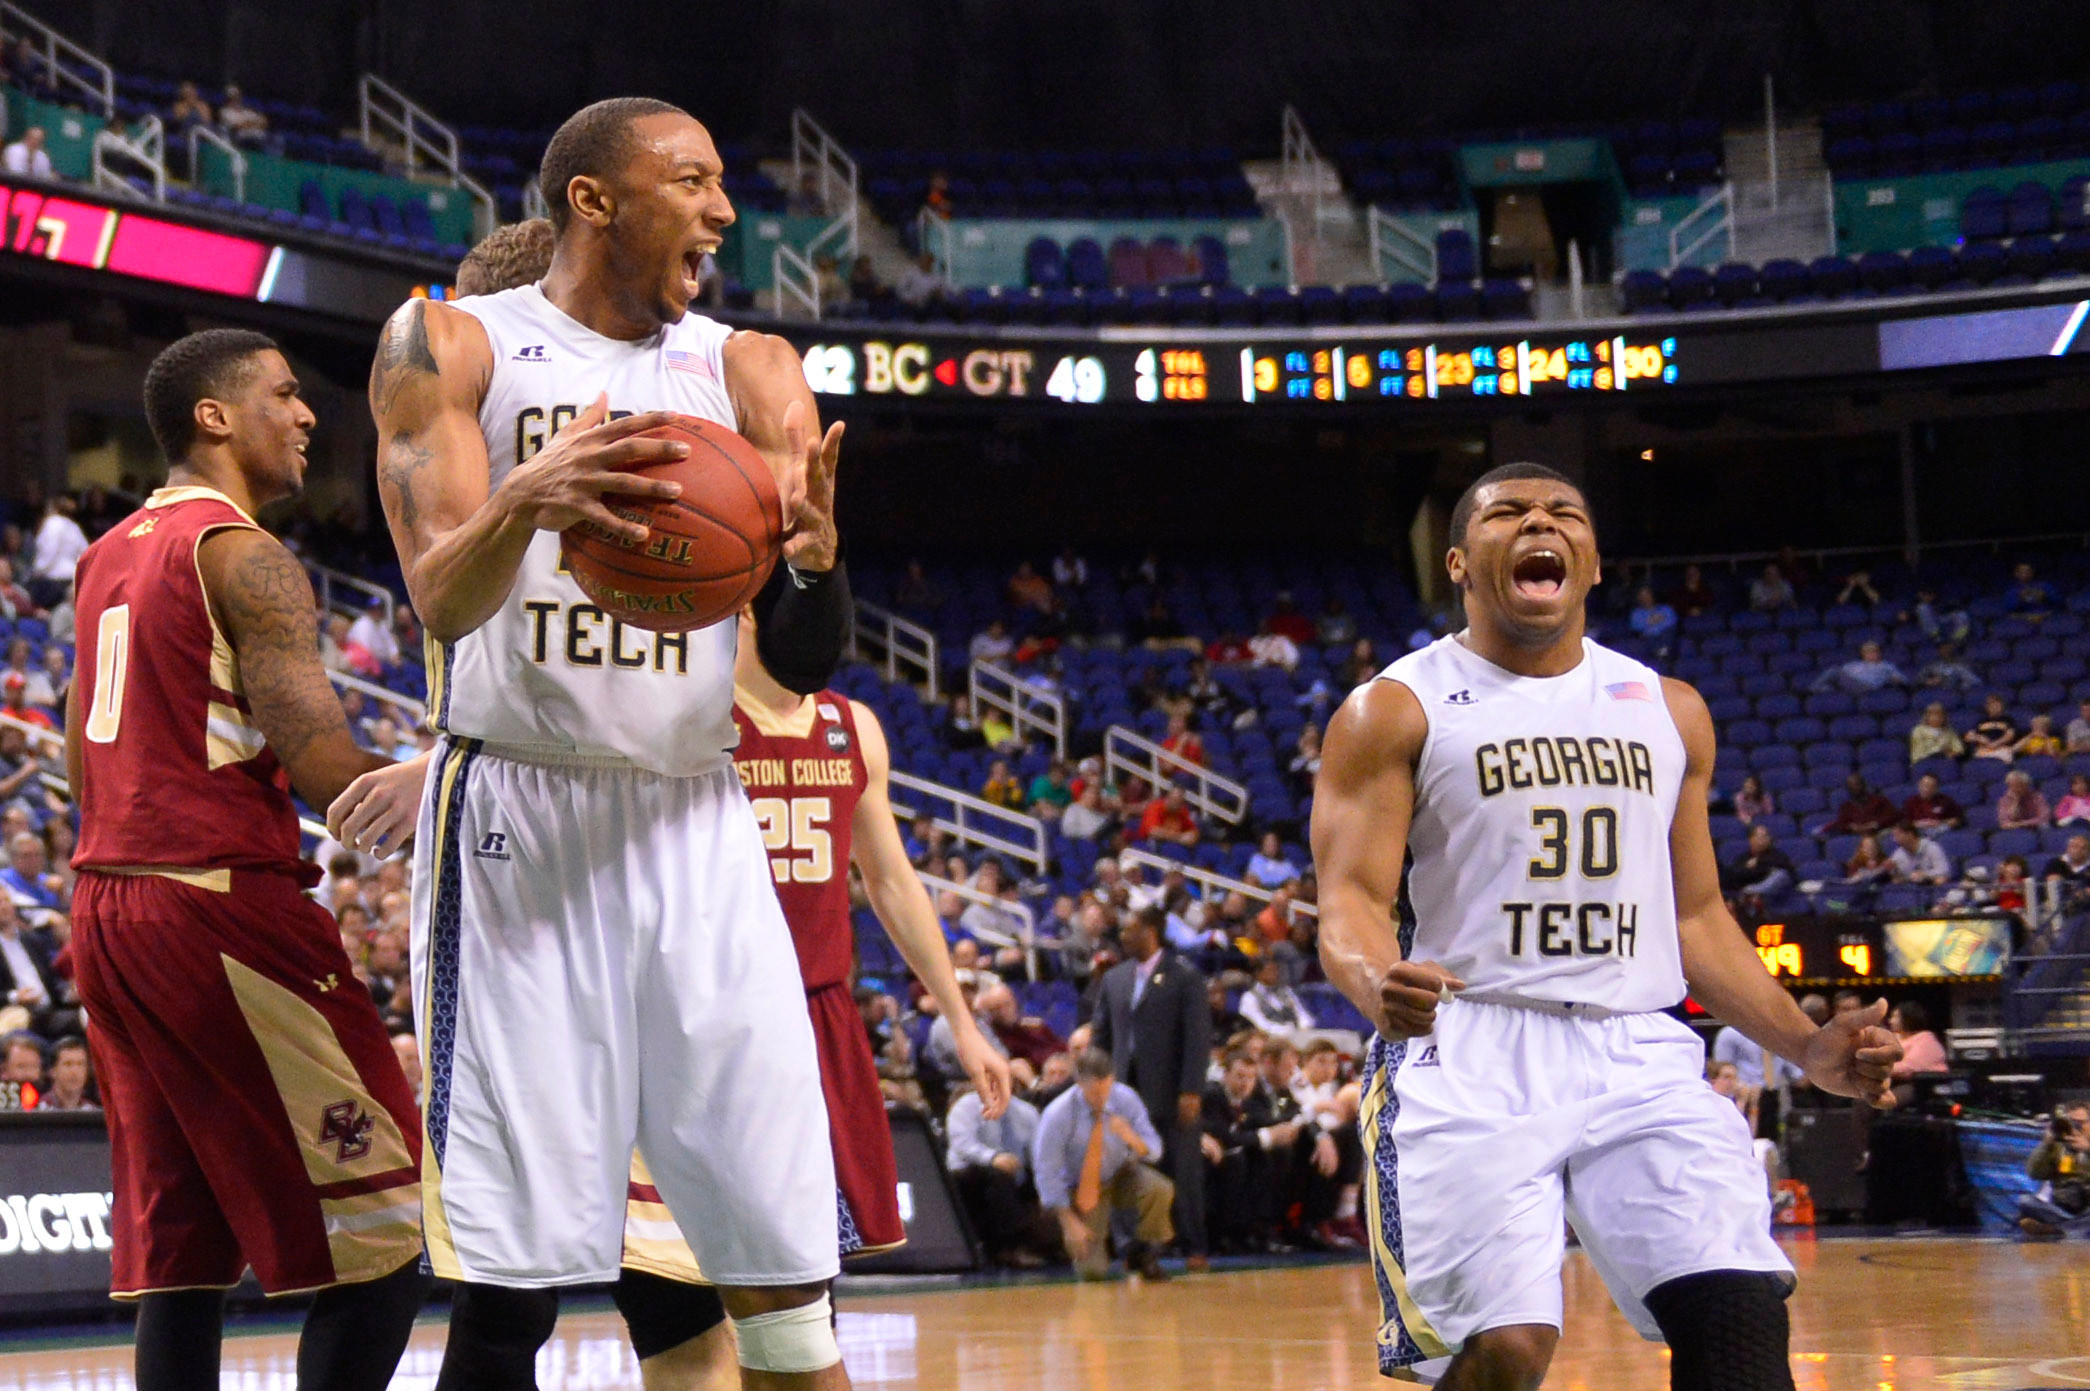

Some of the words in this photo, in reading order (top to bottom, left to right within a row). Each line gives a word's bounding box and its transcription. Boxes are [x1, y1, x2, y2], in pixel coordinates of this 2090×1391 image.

[802, 343, 855, 395] 42
[863, 342, 929, 395] BC
[962, 350, 1031, 396] GT
[1046, 355, 1106, 402] 49
[1529, 348, 1569, 382] 24
[1624, 345, 1663, 379] 30
[523, 599, 688, 675] TECH
[85, 603, 129, 743] 0
[734, 758, 786, 786] STON
[792, 758, 853, 786] COLLEGE
[1475, 735, 1656, 799] GEORGIA
[751, 797, 832, 883] 25
[1526, 804, 1621, 882] 30
[1501, 899, 1637, 958] TECH
[1755, 943, 1802, 976] 49
[1840, 944, 1870, 976] 4
